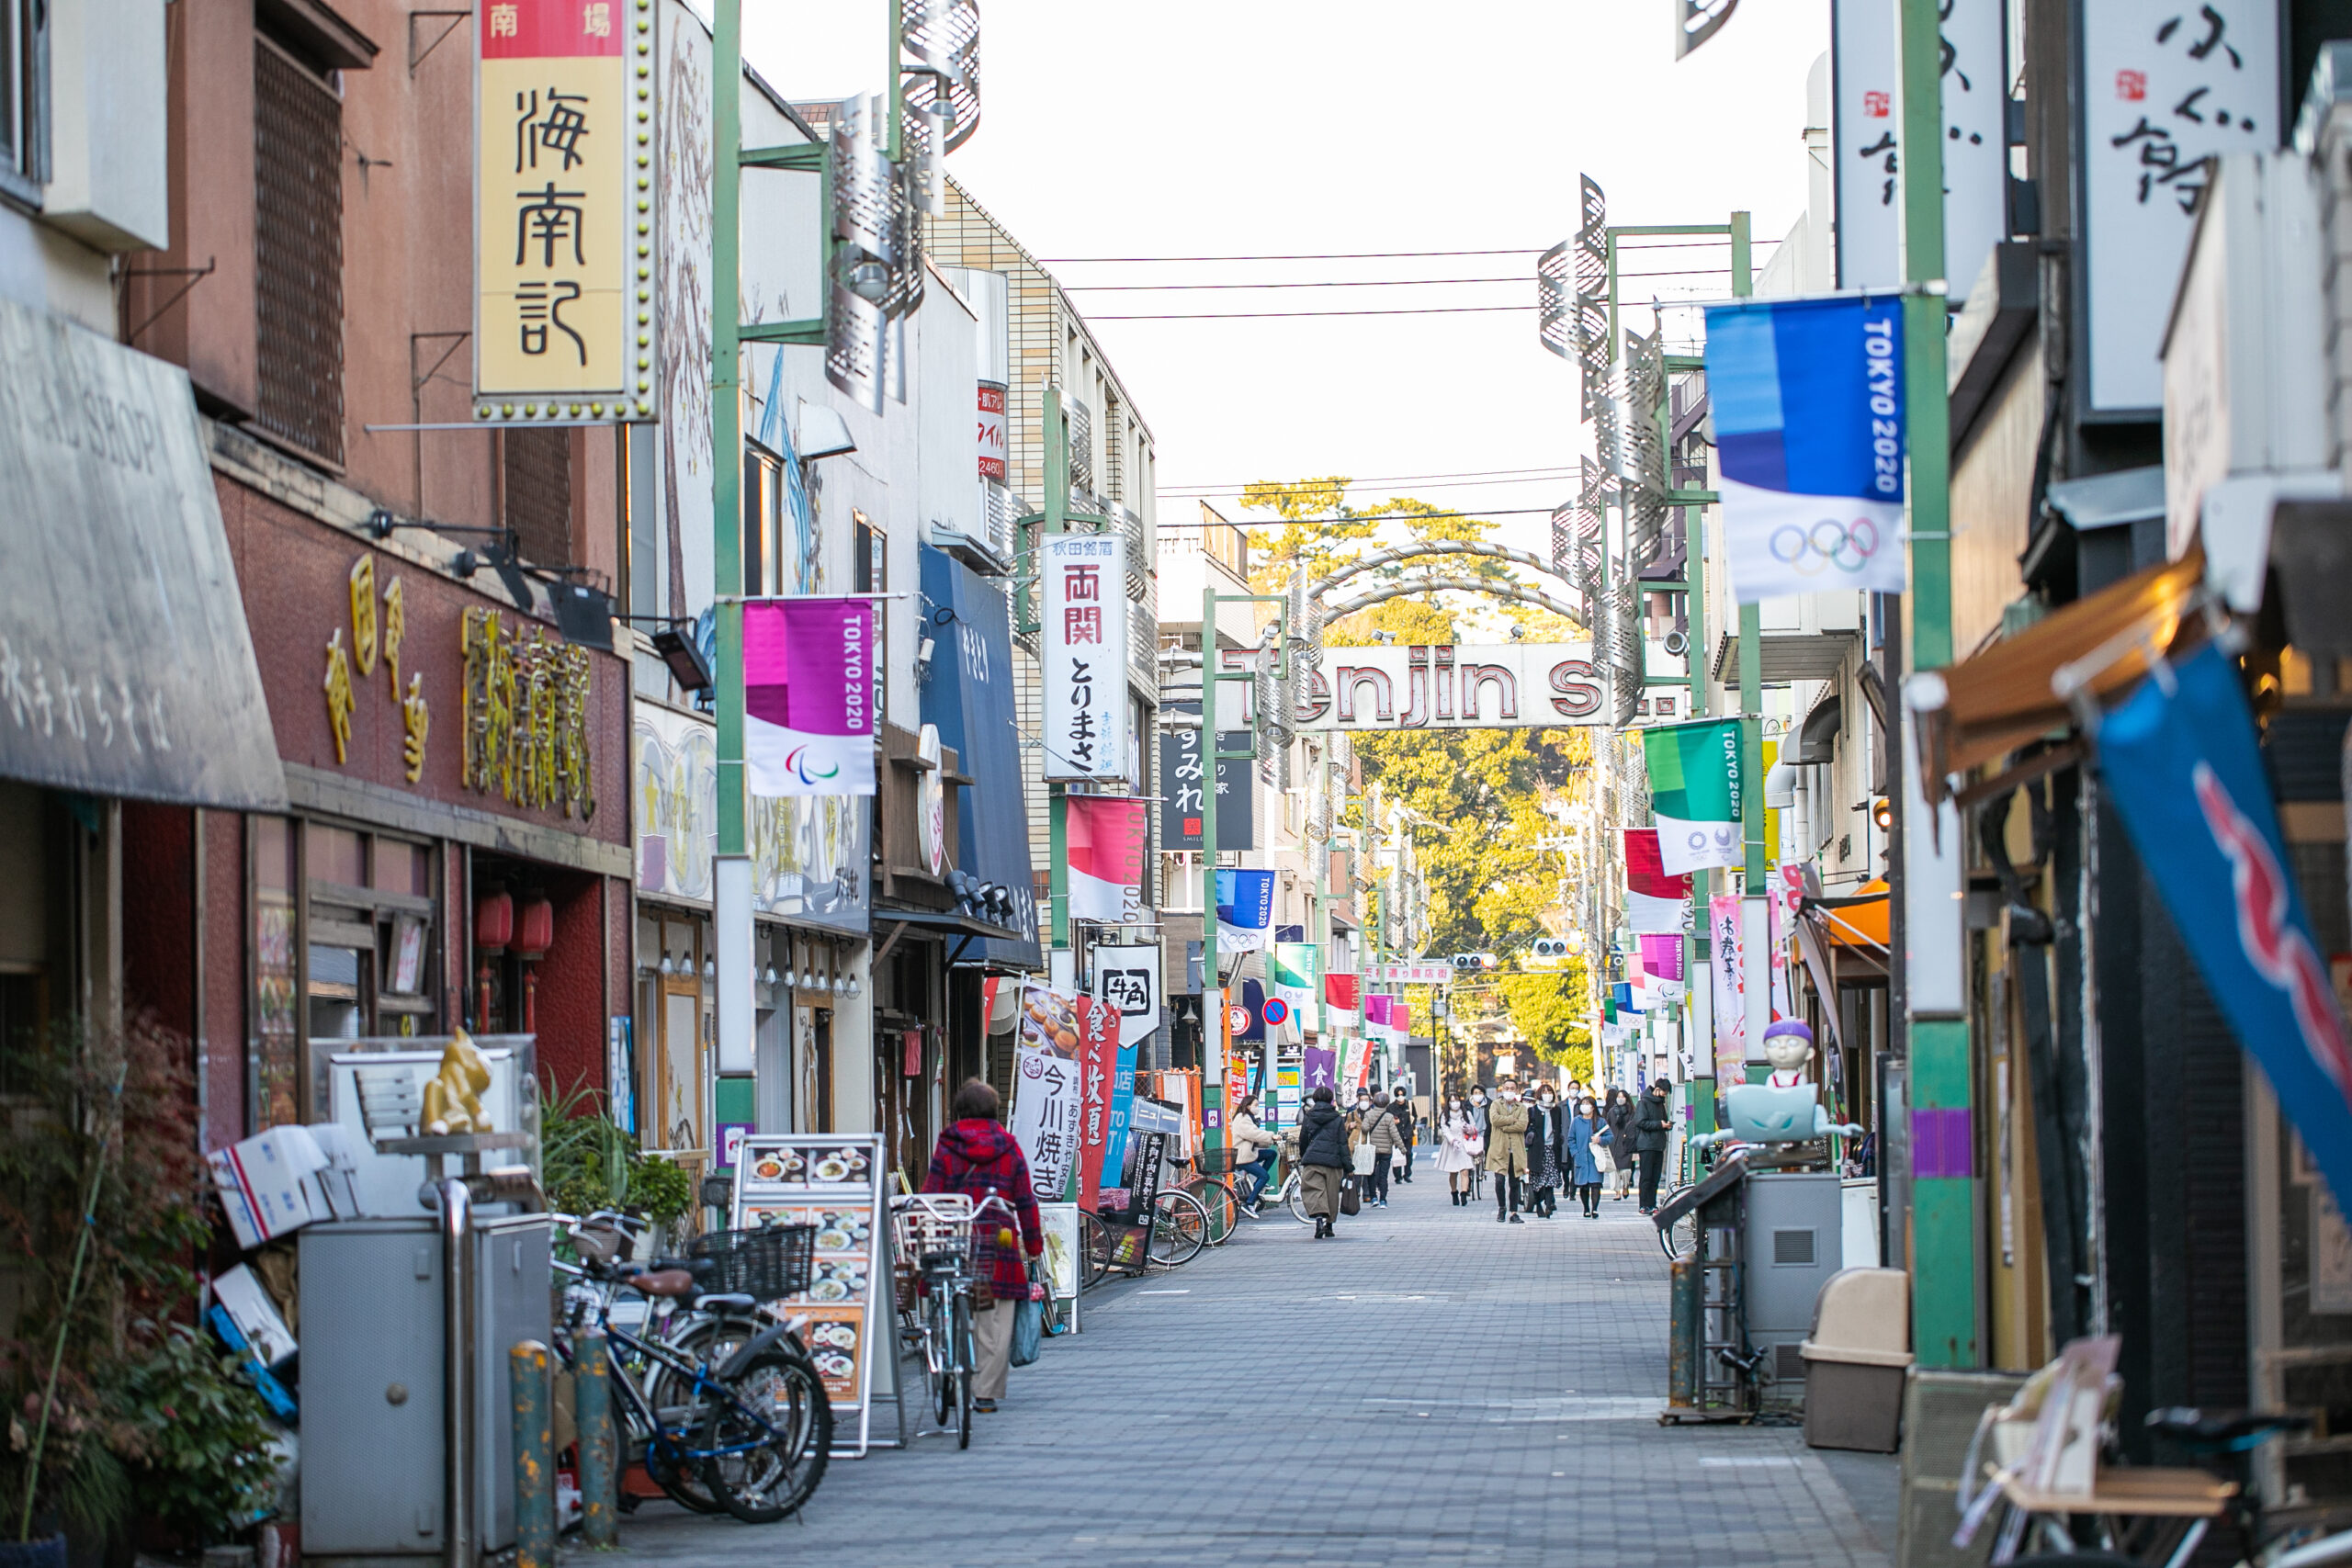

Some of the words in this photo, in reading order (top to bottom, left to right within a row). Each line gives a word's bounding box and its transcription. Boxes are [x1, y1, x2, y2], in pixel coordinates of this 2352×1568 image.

[514, 86, 591, 367] 海南記
[1863, 318, 1896, 416] TOKYO
[83, 390, 155, 474] SHOP
[1872, 419, 1898, 493] 2020
[1053, 541, 1113, 556] 秋田銘酒
[1063, 564, 1102, 645] 両関
[842, 615, 863, 681] TOKYO
[844, 682, 864, 730] 2020
[1069, 657, 1097, 773] とりまさ
[1722, 730, 1738, 779] TOKYO
[1729, 782, 1740, 818] 2020
[1123, 873, 1142, 923] 2020
[1258, 906, 1266, 926] 2020
[1260, 878, 1270, 906] TOKYO
[1109, 978, 1146, 1005] 牛角
[1032, 1064, 1066, 1198] 今川焼き
